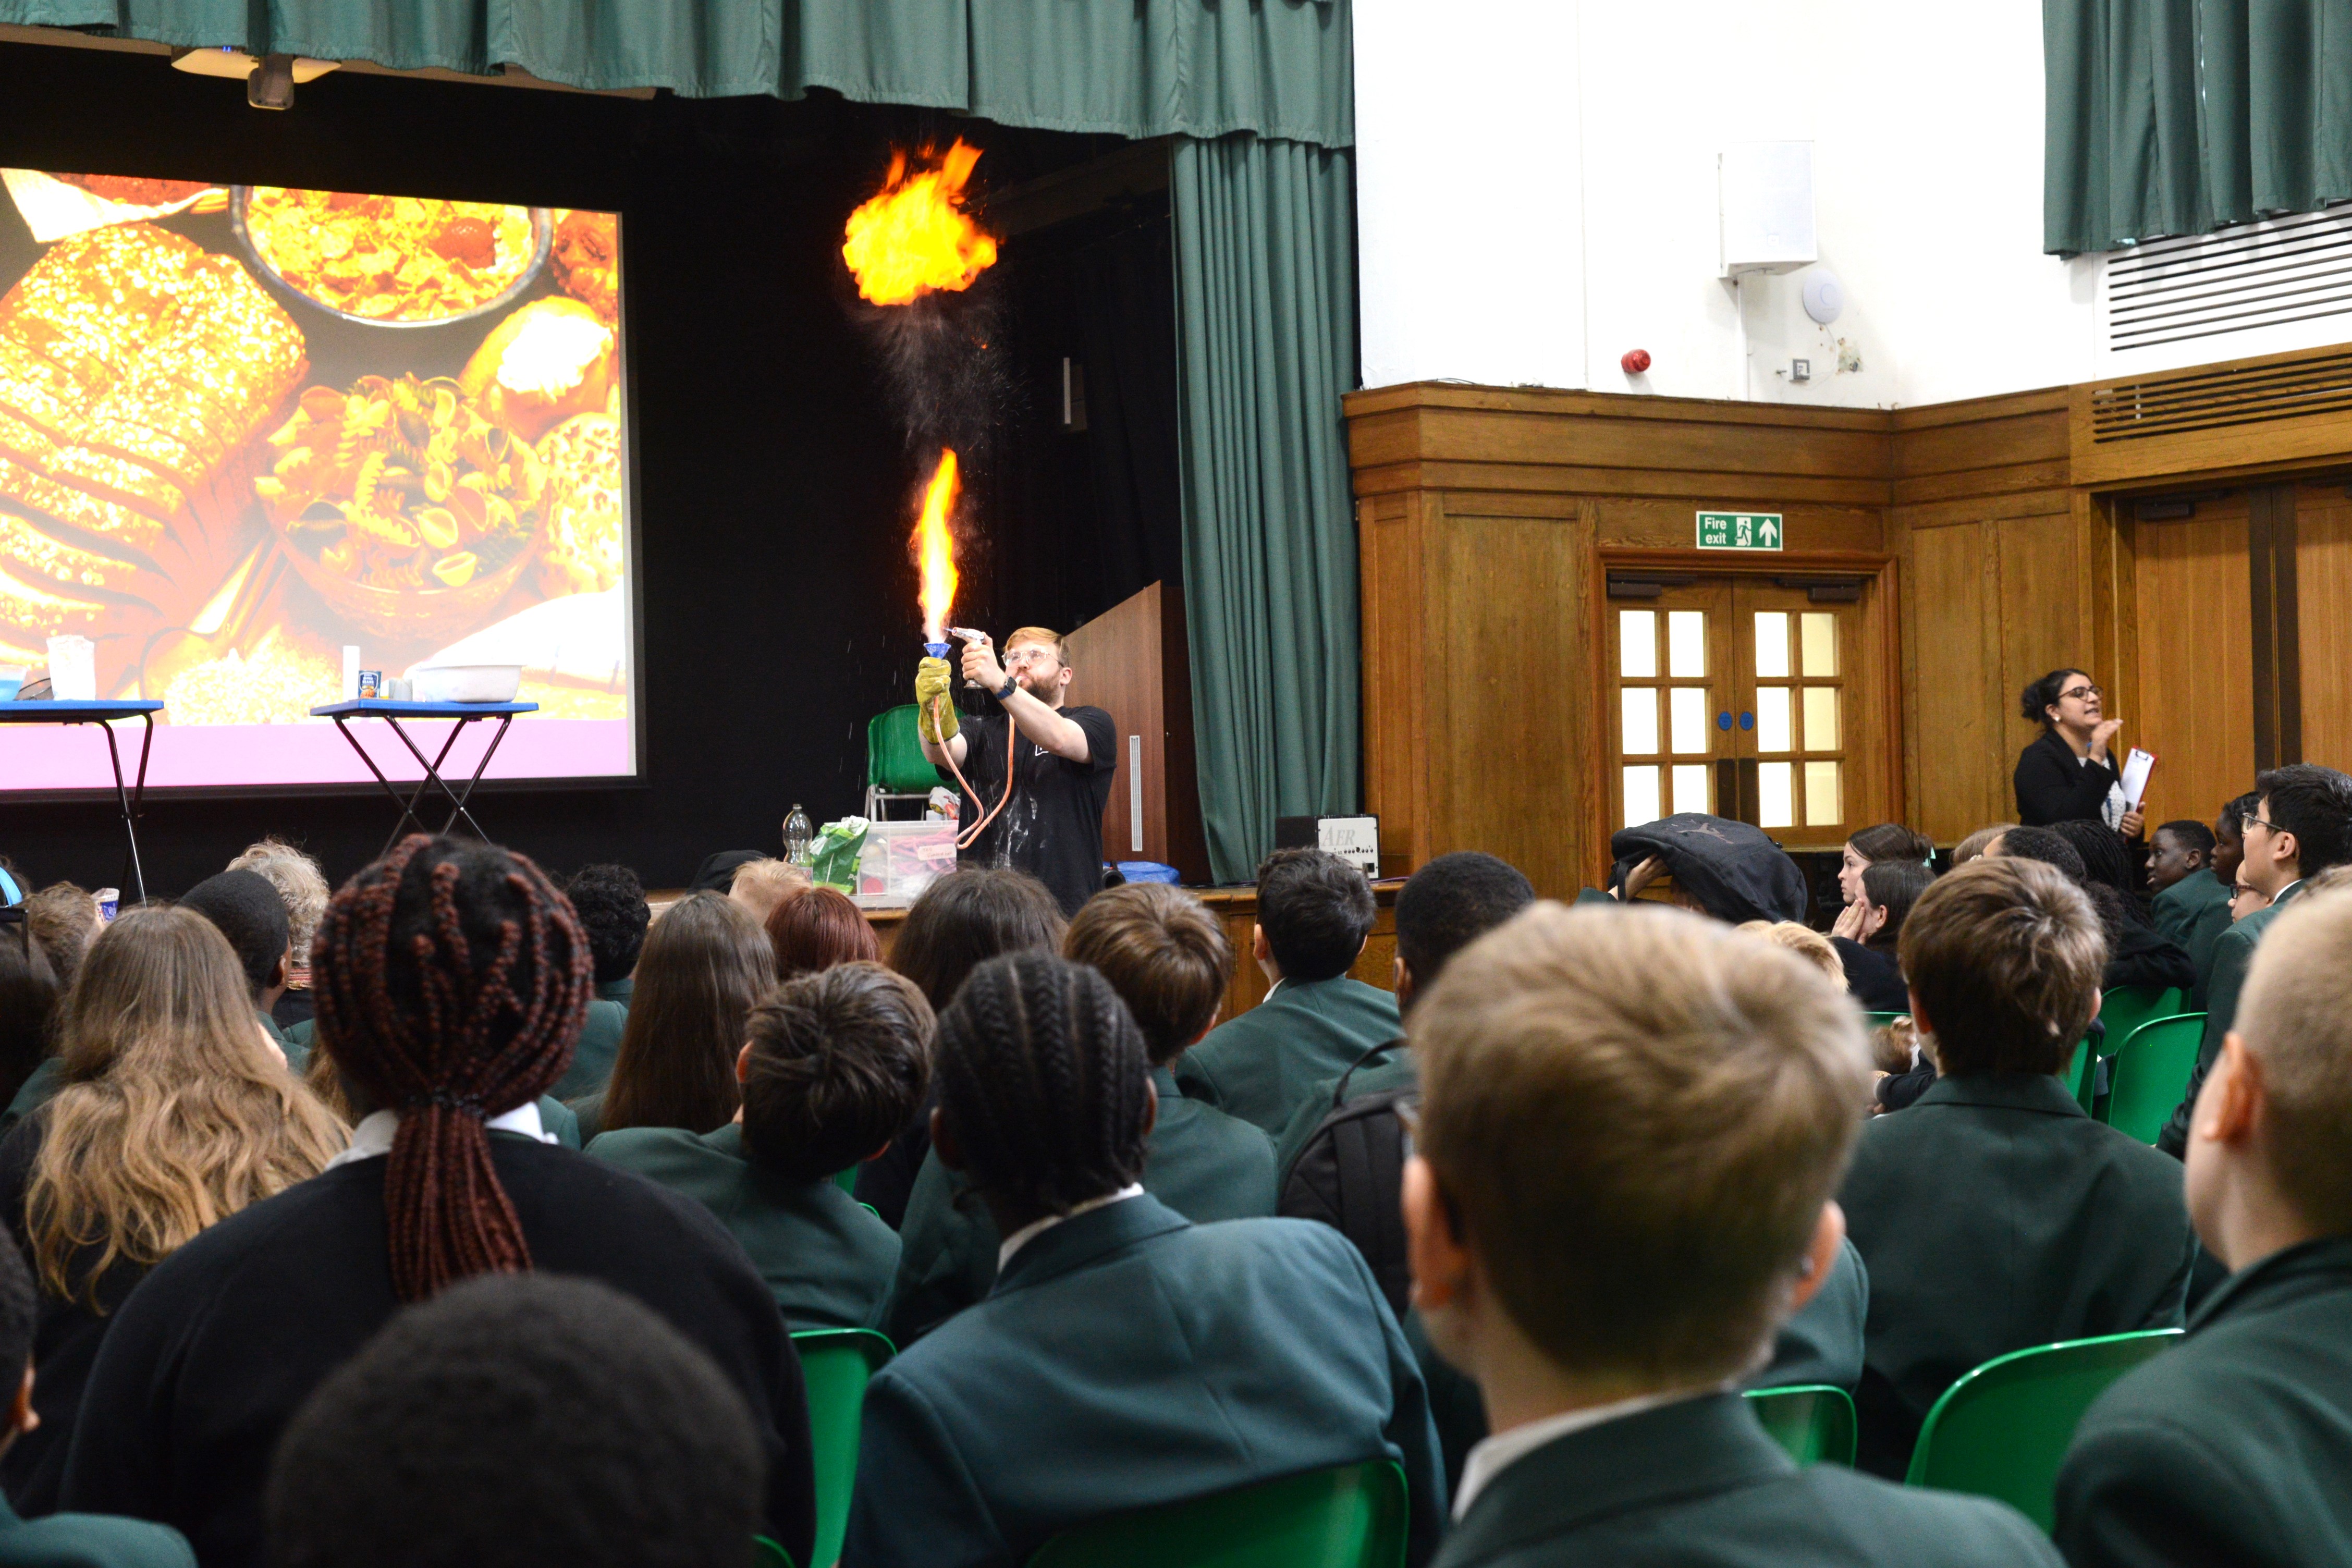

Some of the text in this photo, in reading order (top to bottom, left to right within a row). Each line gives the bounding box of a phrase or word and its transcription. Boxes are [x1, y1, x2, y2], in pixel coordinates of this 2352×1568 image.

[1705, 517, 1727, 530] Fire
[1705, 532, 1726, 544] exit
[1321, 826, 1355, 846] AER
